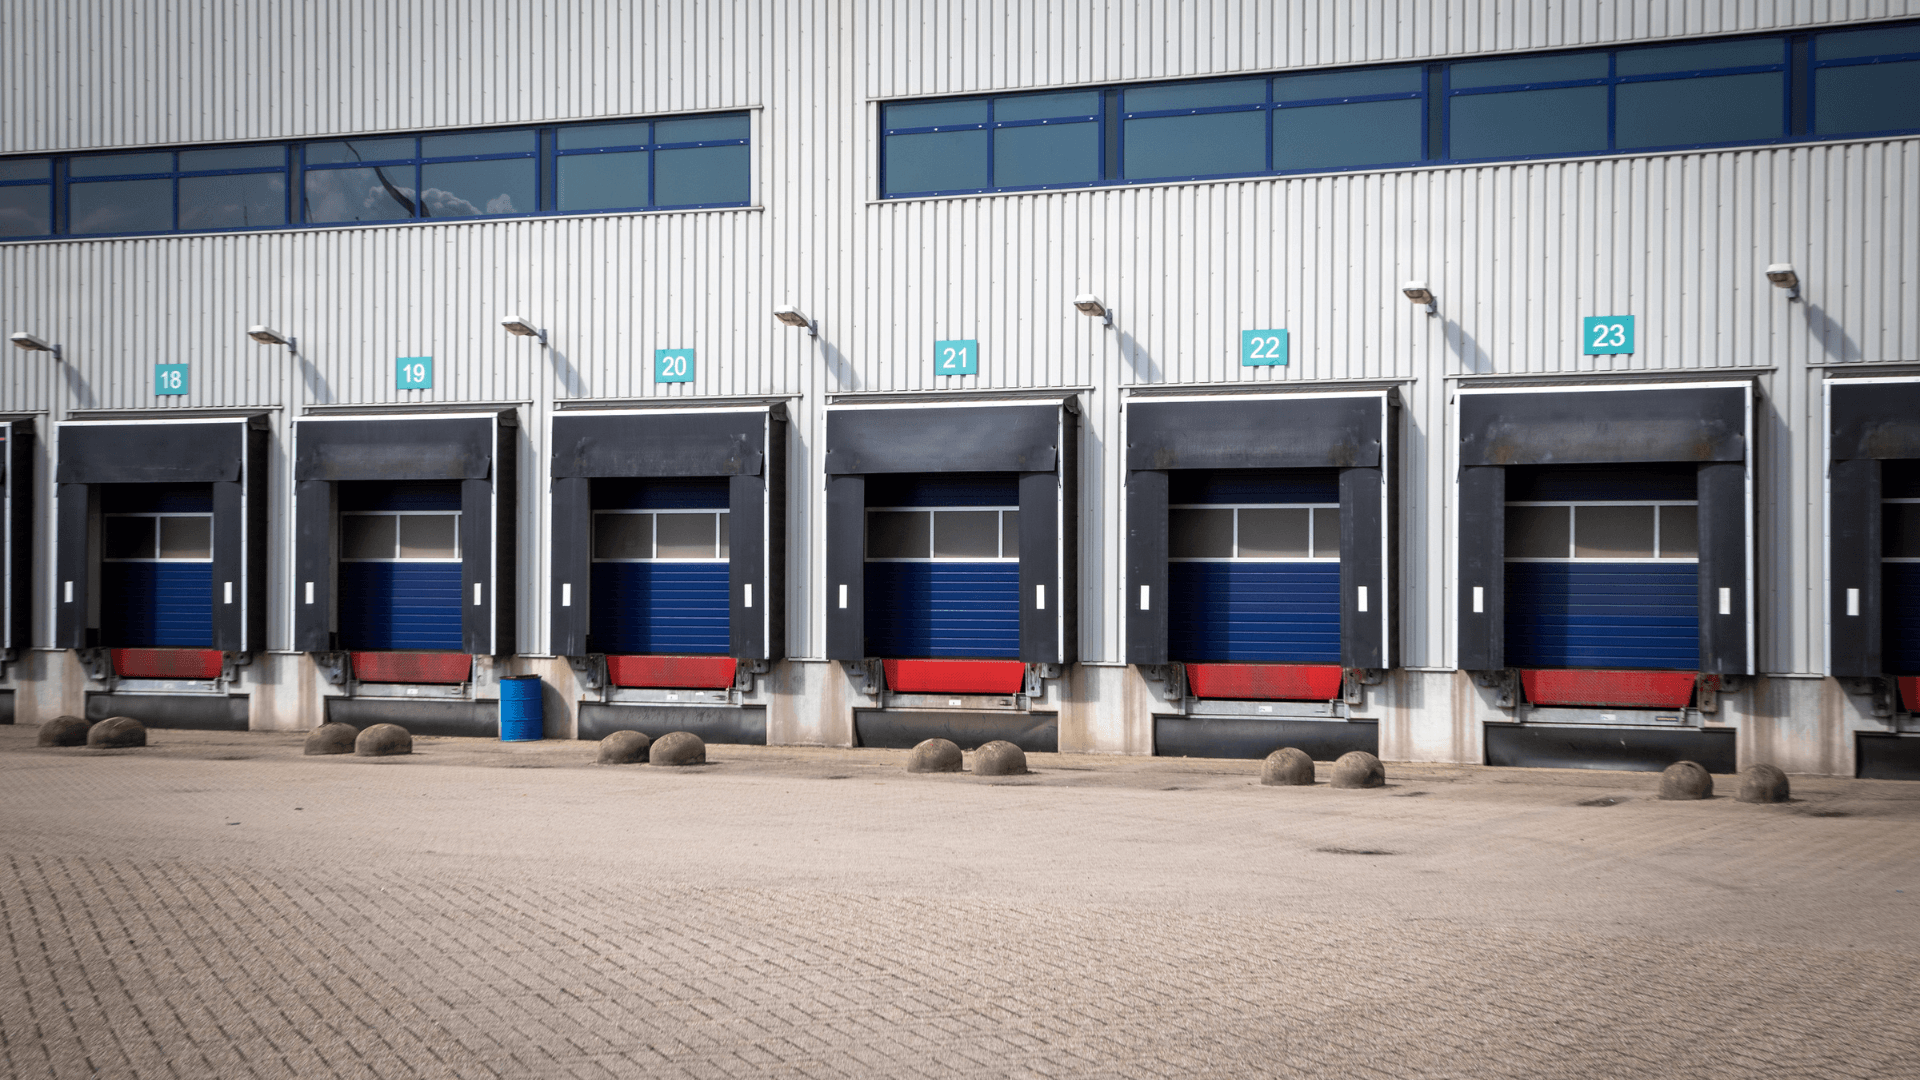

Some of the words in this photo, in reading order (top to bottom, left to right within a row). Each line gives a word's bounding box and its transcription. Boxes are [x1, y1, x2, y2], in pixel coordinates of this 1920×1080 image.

[1592, 324, 1626, 347] 23
[942, 347, 967, 368] 21
[1249, 337, 1280, 359] 22
[402, 364, 426, 383] 19
[661, 356, 687, 377] 20
[160, 371, 182, 390] 18
